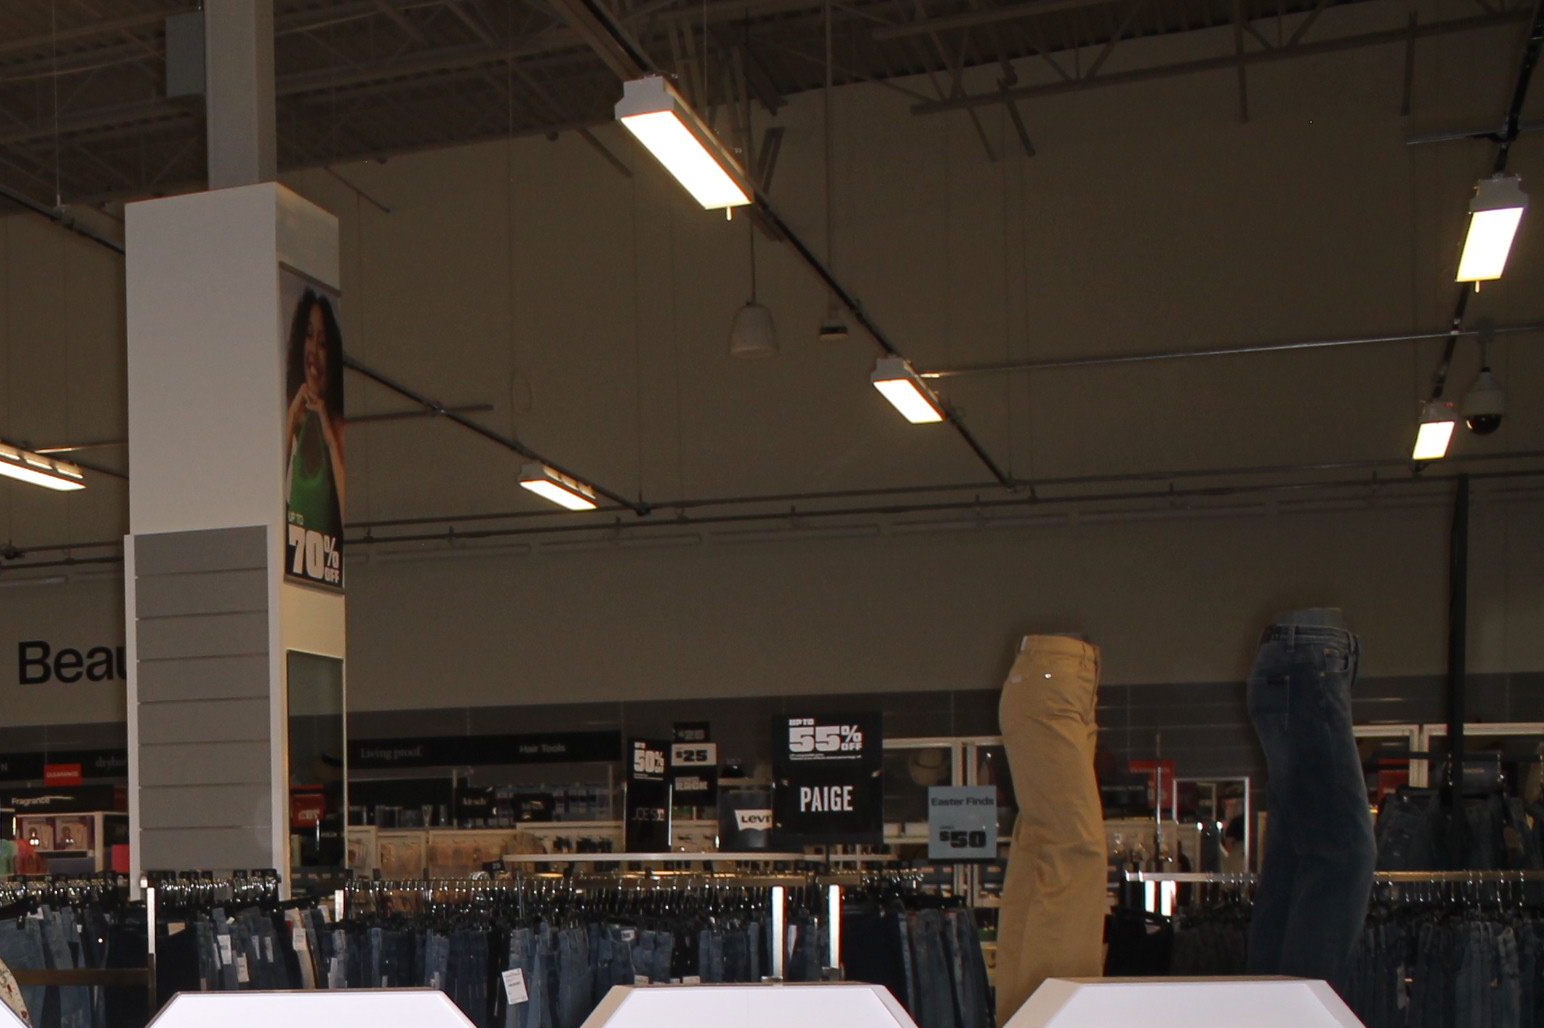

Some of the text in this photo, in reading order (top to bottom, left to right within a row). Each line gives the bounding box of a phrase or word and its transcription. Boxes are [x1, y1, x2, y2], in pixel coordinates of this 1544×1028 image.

[288, 523, 340, 579] 70%
[788, 724, 862, 752] 55%
[360, 748, 388, 760] Living
[841, 742, 862, 751] OFF
[675, 749, 708, 762] $25
[11, 797, 51, 807] Fragrance
[800, 785, 853, 813] PAIGE
[939, 831, 986, 848] $50
